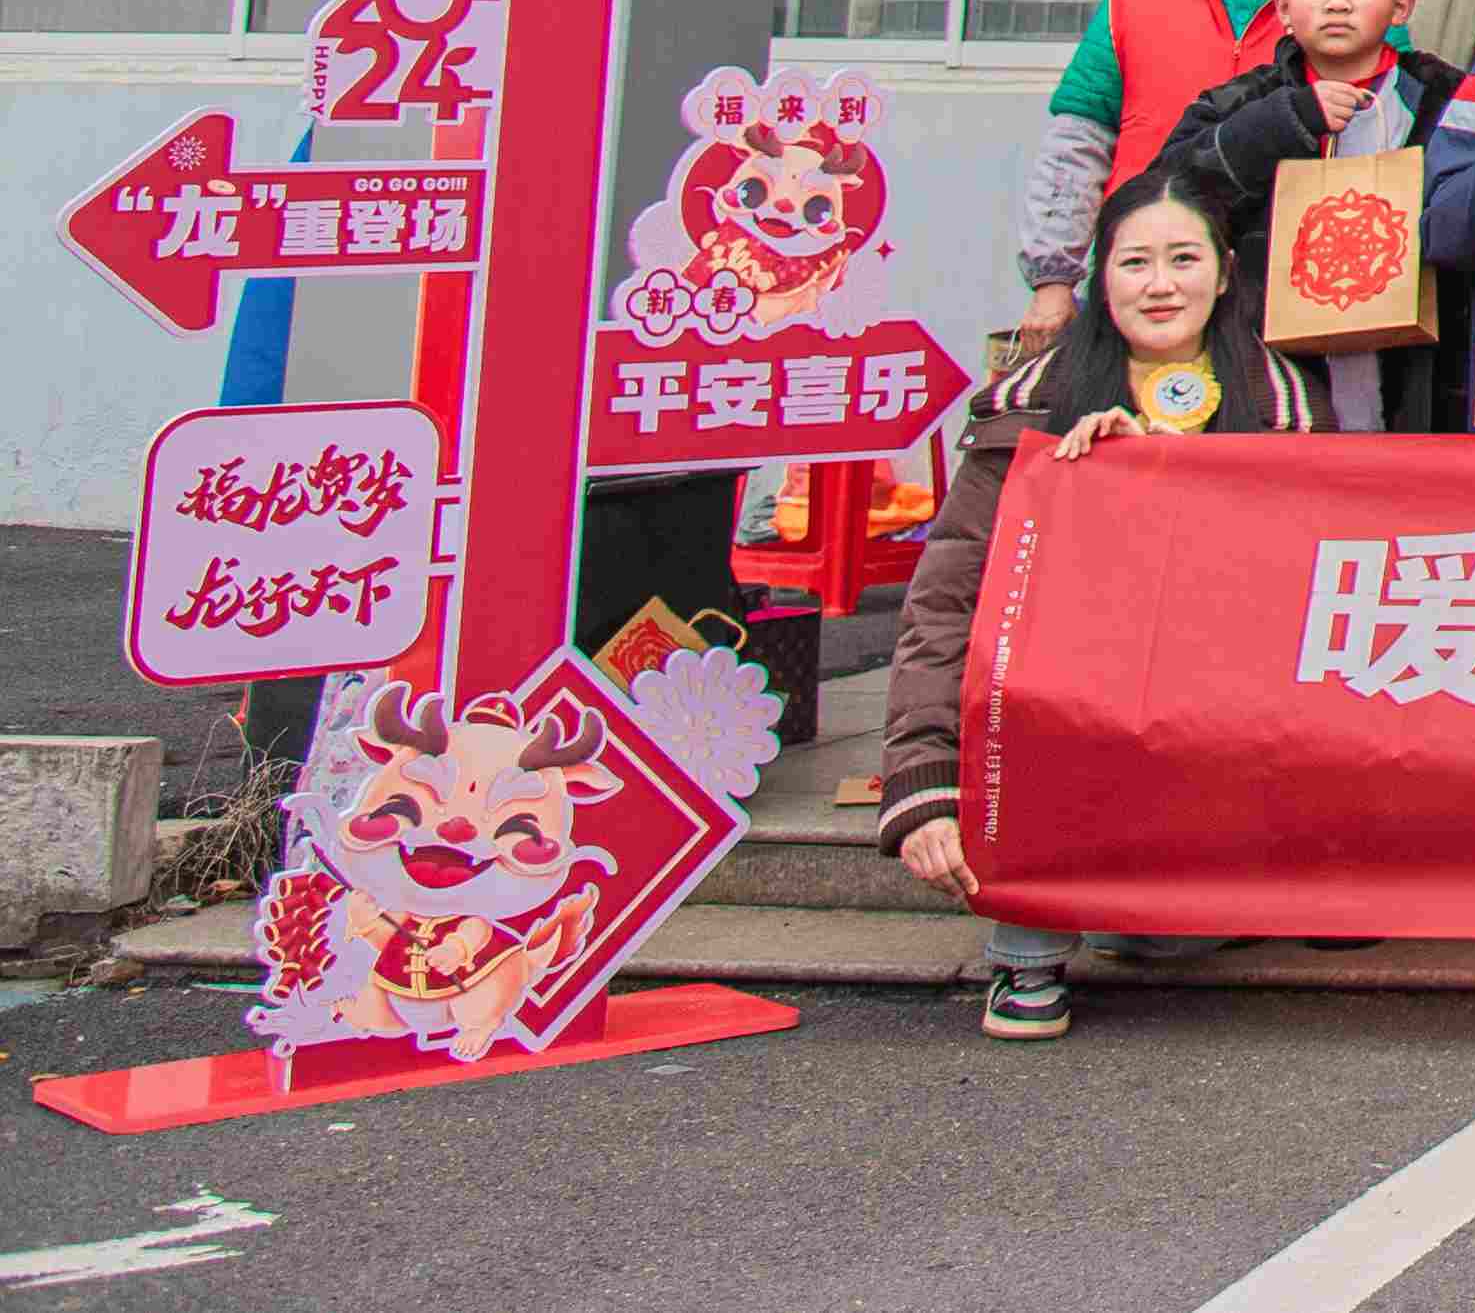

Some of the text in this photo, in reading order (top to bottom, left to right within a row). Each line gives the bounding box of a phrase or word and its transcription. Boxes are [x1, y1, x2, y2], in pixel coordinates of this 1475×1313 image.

[311, 45, 330, 116] HAPPY
[713, 94, 868, 126] 福来到
[354, 177, 383, 191] GO
[388, 177, 417, 191] GO
[646, 287, 737, 316] 新春
[610, 350, 928, 433] 平安喜乐
[175, 444, 413, 538] 福龙贺岁
[165, 557, 399, 638] 龙行天下
